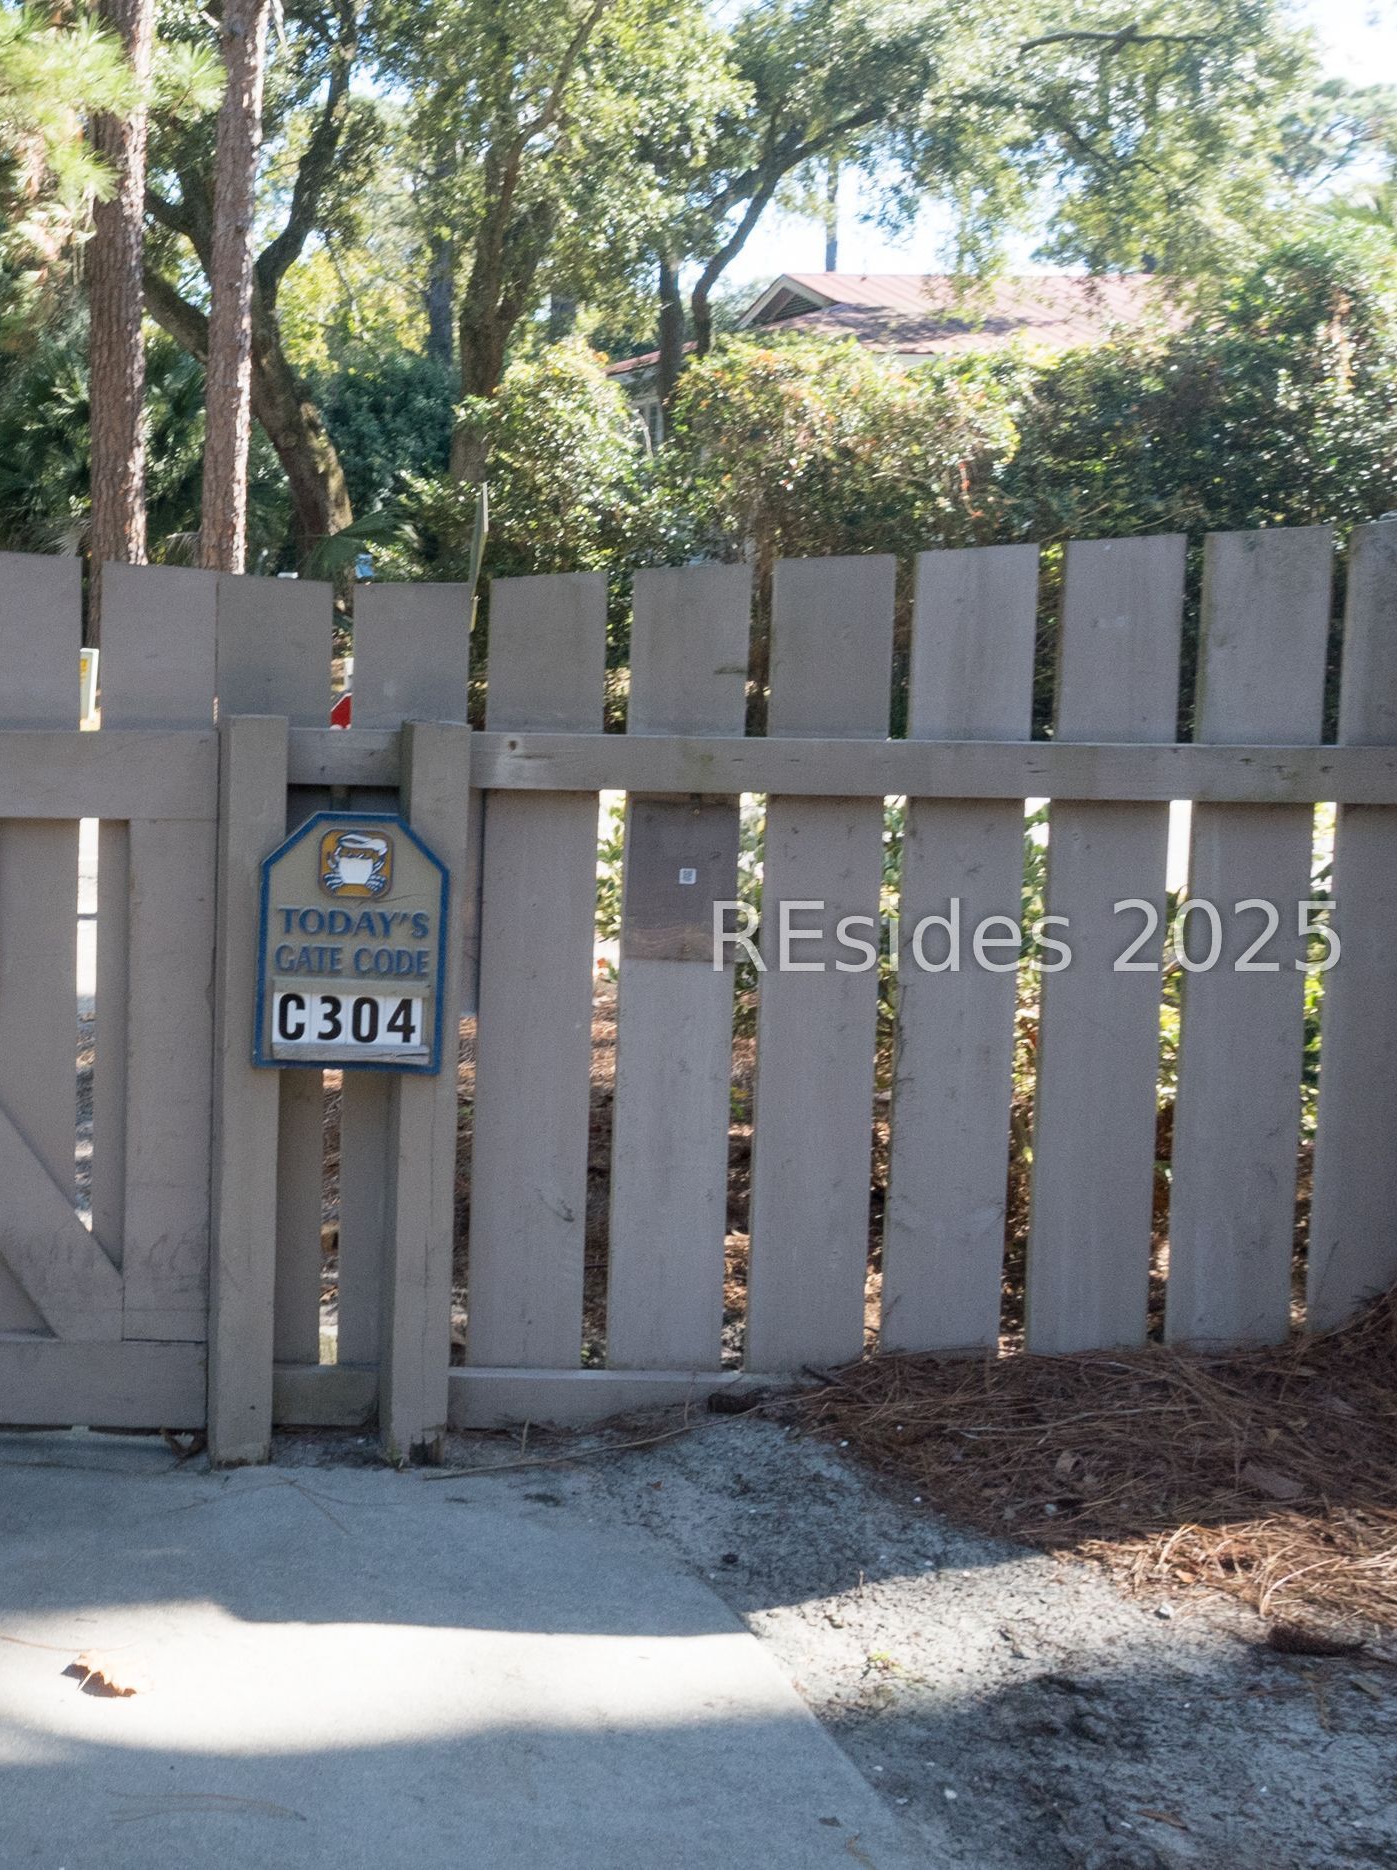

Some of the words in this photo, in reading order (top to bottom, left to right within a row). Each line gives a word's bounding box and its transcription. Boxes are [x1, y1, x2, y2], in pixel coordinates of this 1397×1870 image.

[278, 907, 429, 939] TODAY'S
[275, 944, 343, 974] GATE
[354, 947, 430, 977] CODE
[278, 993, 416, 1043] C304
